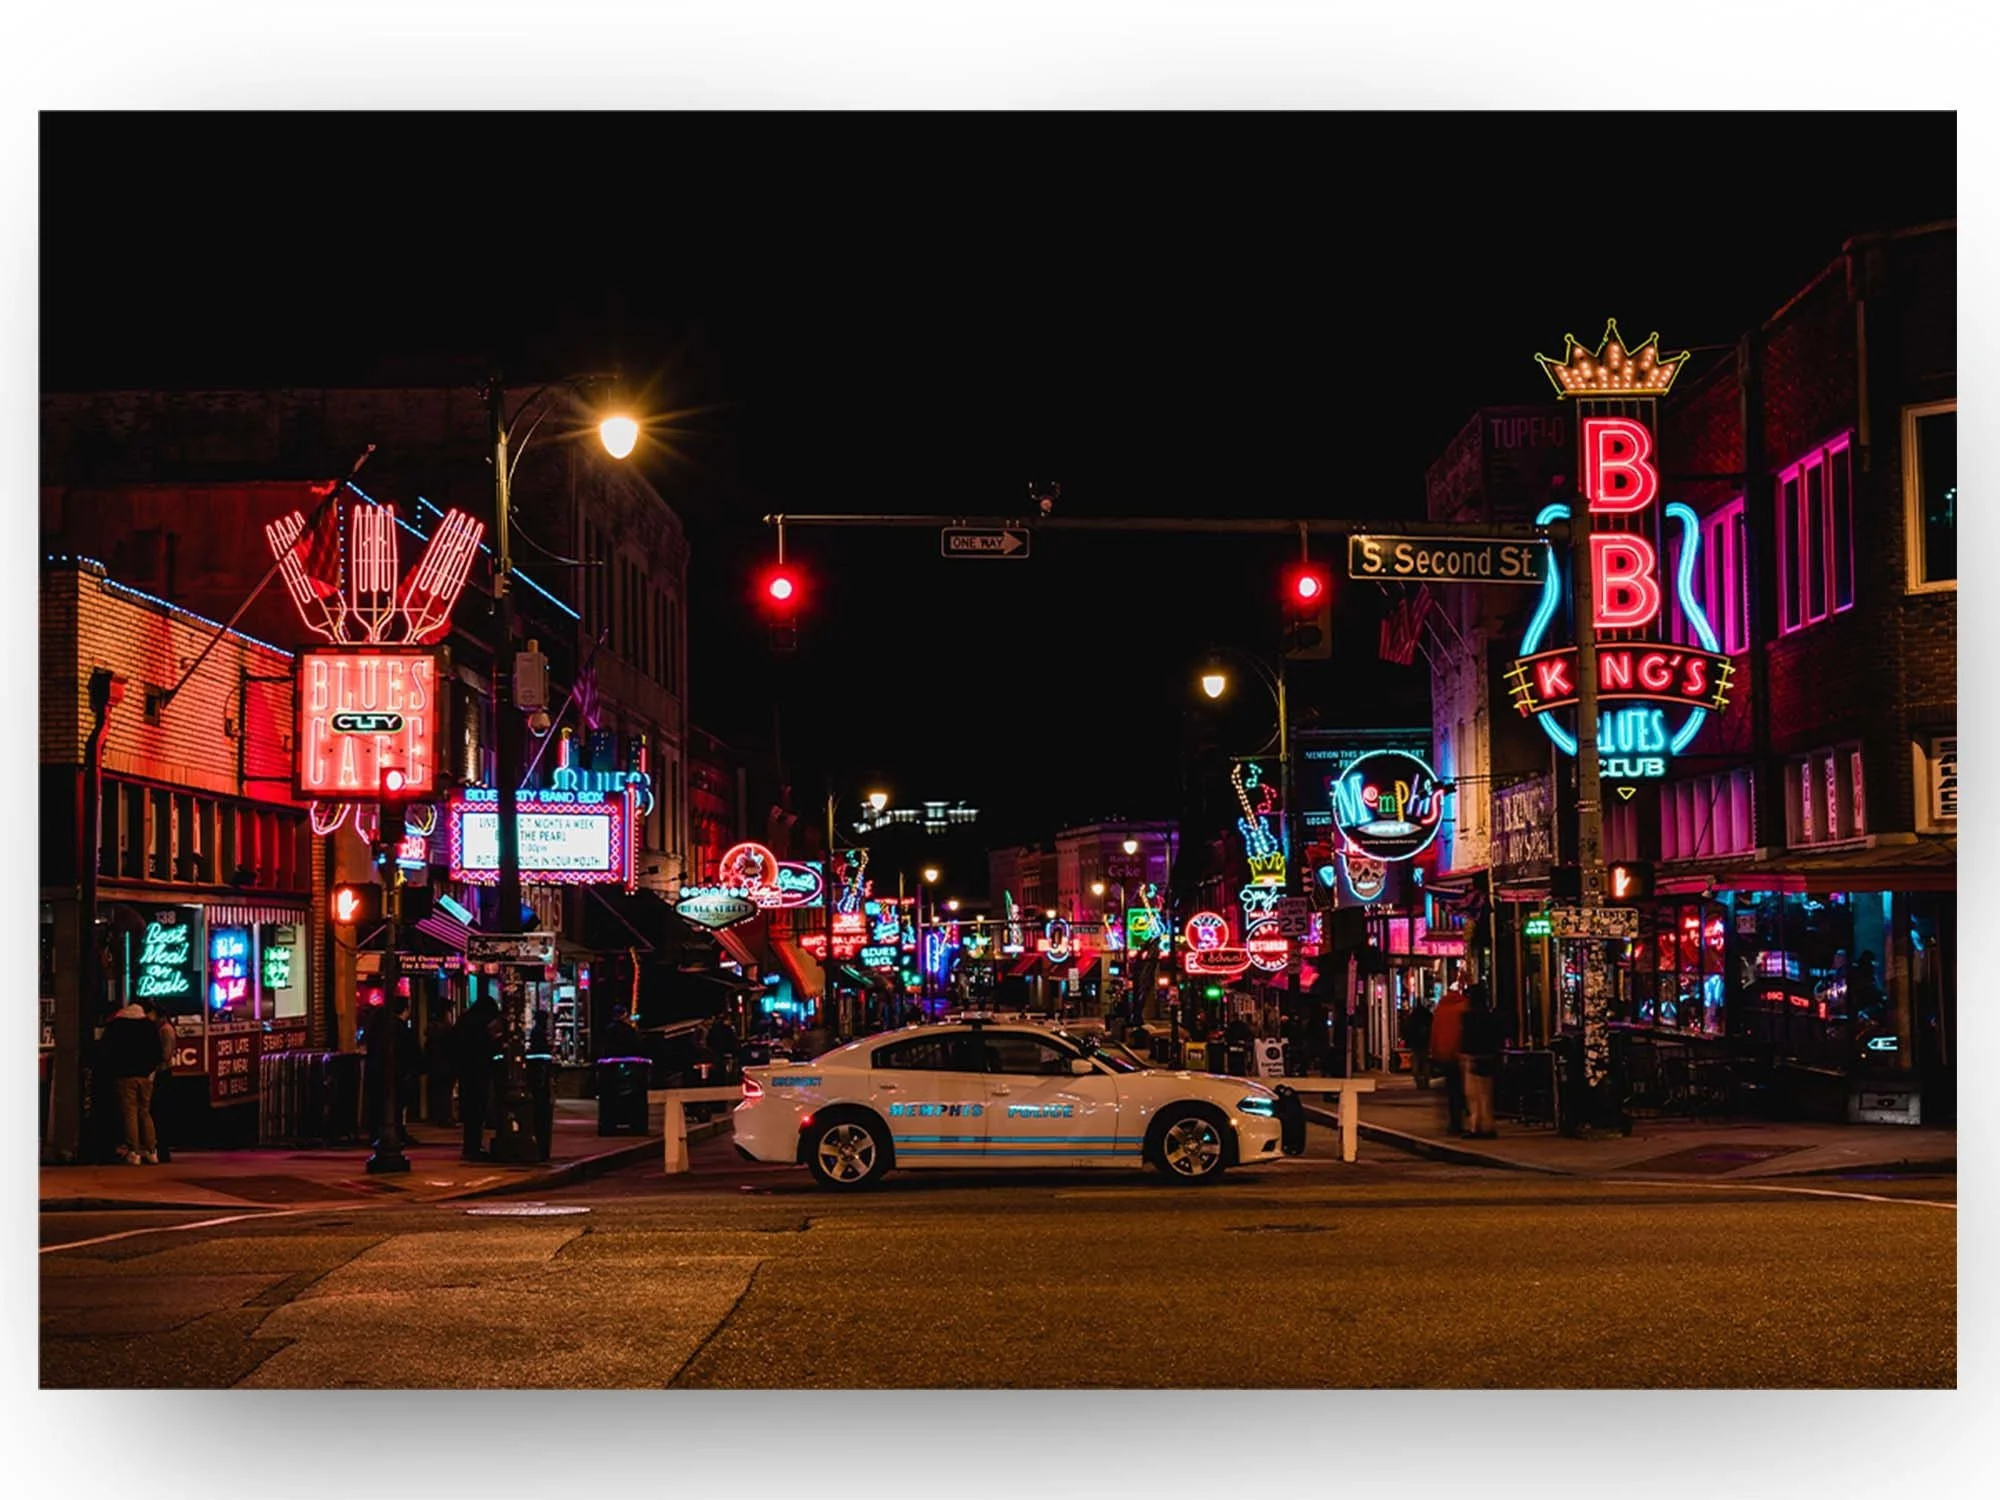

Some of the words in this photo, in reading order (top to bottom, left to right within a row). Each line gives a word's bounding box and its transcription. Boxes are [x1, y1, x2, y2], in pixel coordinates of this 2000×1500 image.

[953, 535, 977, 549] ONE
[980, 535, 1002, 549] WAY
[1362, 542, 1387, 574] S.
[1393, 543, 1492, 576] Second
[1499, 545, 1537, 577] St.
[310, 659, 429, 711] BLUES
[1535, 650, 1708, 700] KNG'S
[336, 714, 399, 729] CITY
[309, 715, 425, 786] CAFE
[464, 788, 499, 803] BLUE
[539, 790, 575, 804] BAND
[577, 791, 605, 804] BOX
[1331, 773, 1444, 827] Memphis
[520, 830, 536, 842] THE
[539, 831, 567, 843] PEARL
[146, 921, 188, 944] Best
[1281, 917, 1307, 933] 25
[139, 942, 189, 964] Meal
[860, 946, 898, 958] BLUES
[137, 974, 189, 997] Beale
[888, 1103, 985, 1118] MEMPHIS
[1007, 1104, 1075, 1119] POLICE
